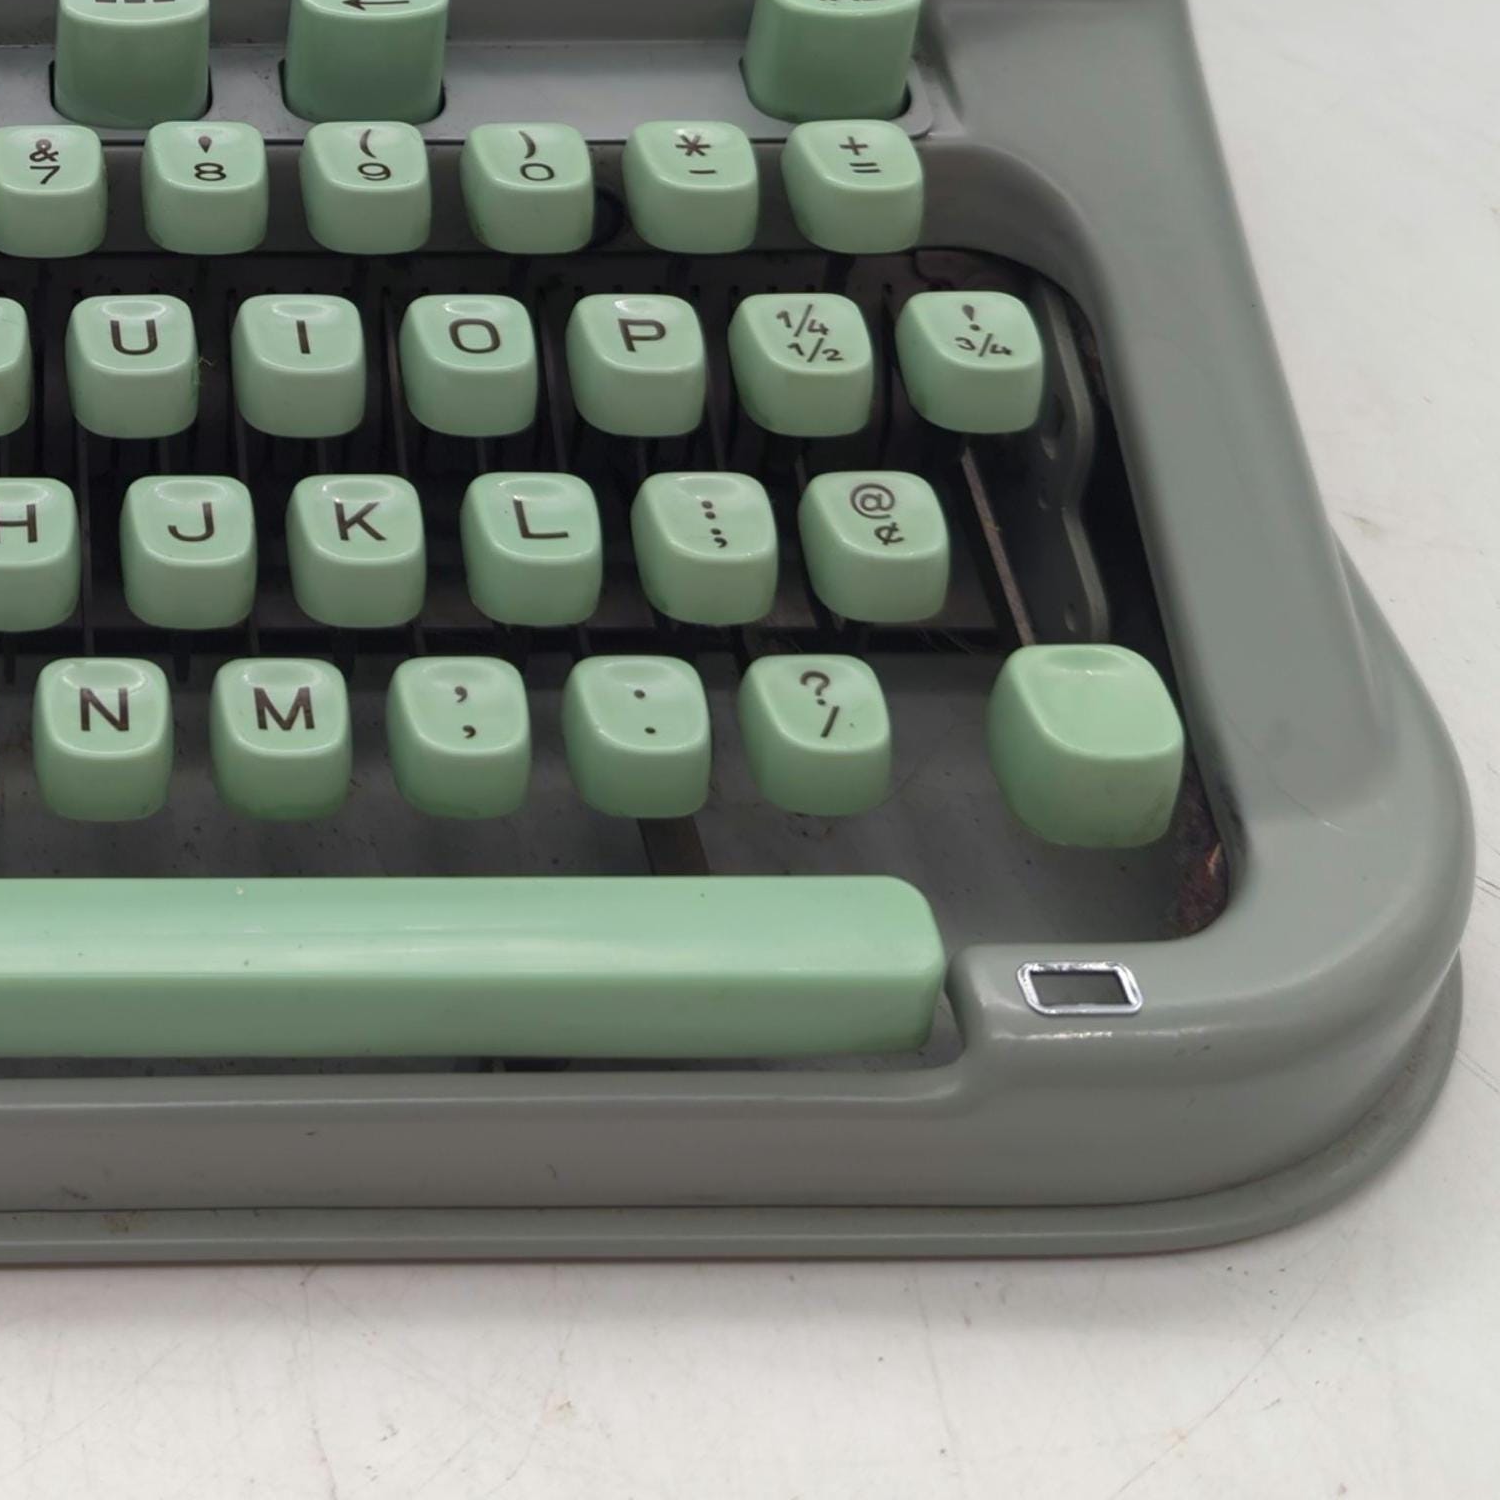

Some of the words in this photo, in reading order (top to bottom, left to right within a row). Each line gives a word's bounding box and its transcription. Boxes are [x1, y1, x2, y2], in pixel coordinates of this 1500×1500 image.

[29, 165, 61, 185] 7
[193, 162, 227, 182] 8
[357, 162, 392, 182] 9
[110, 319, 159, 356] U
[618, 318, 667, 353] P
[167, 502, 215, 543] J
[334, 502, 387, 542] K
[512, 499, 570, 540] L
[79, 687, 130, 732] N
[253, 686, 316, 732] M
